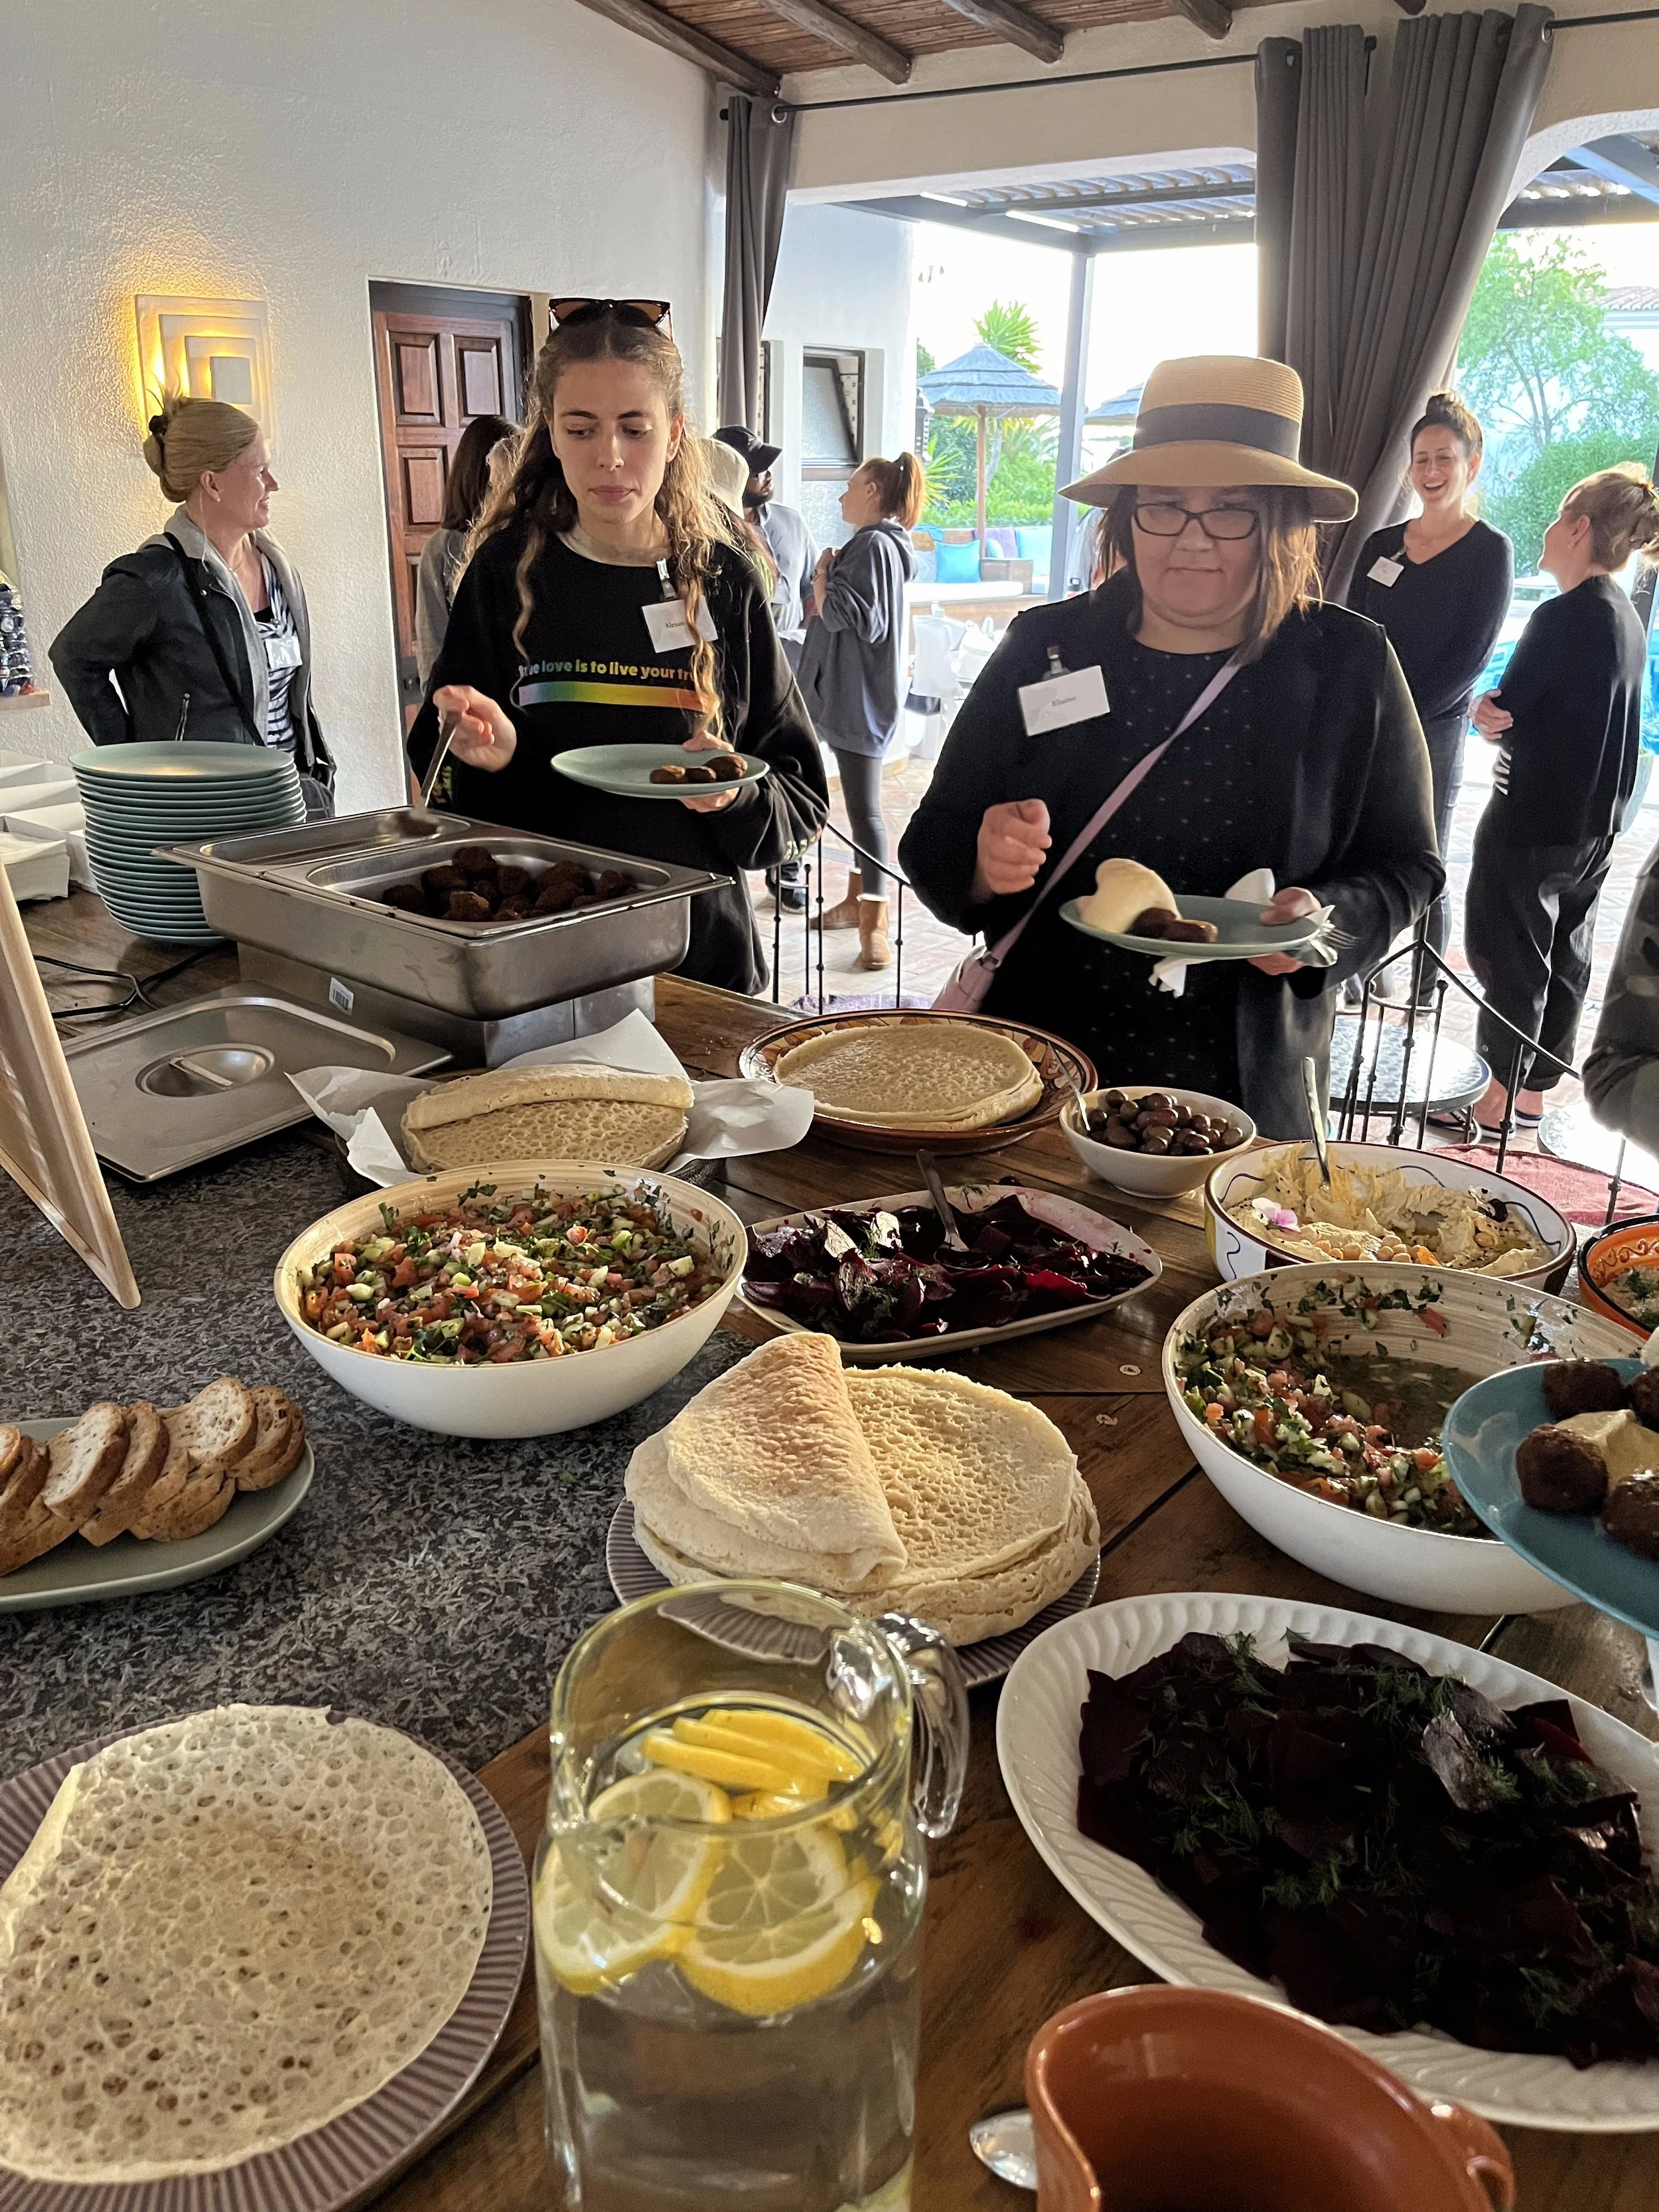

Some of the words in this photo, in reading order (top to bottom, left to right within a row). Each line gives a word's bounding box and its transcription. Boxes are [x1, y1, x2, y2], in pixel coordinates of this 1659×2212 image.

[541, 660, 573, 672] love
[575, 659, 588, 672] is
[591, 661, 607, 674] to
[609, 662, 638, 676] live
[640, 666, 676, 680] your
